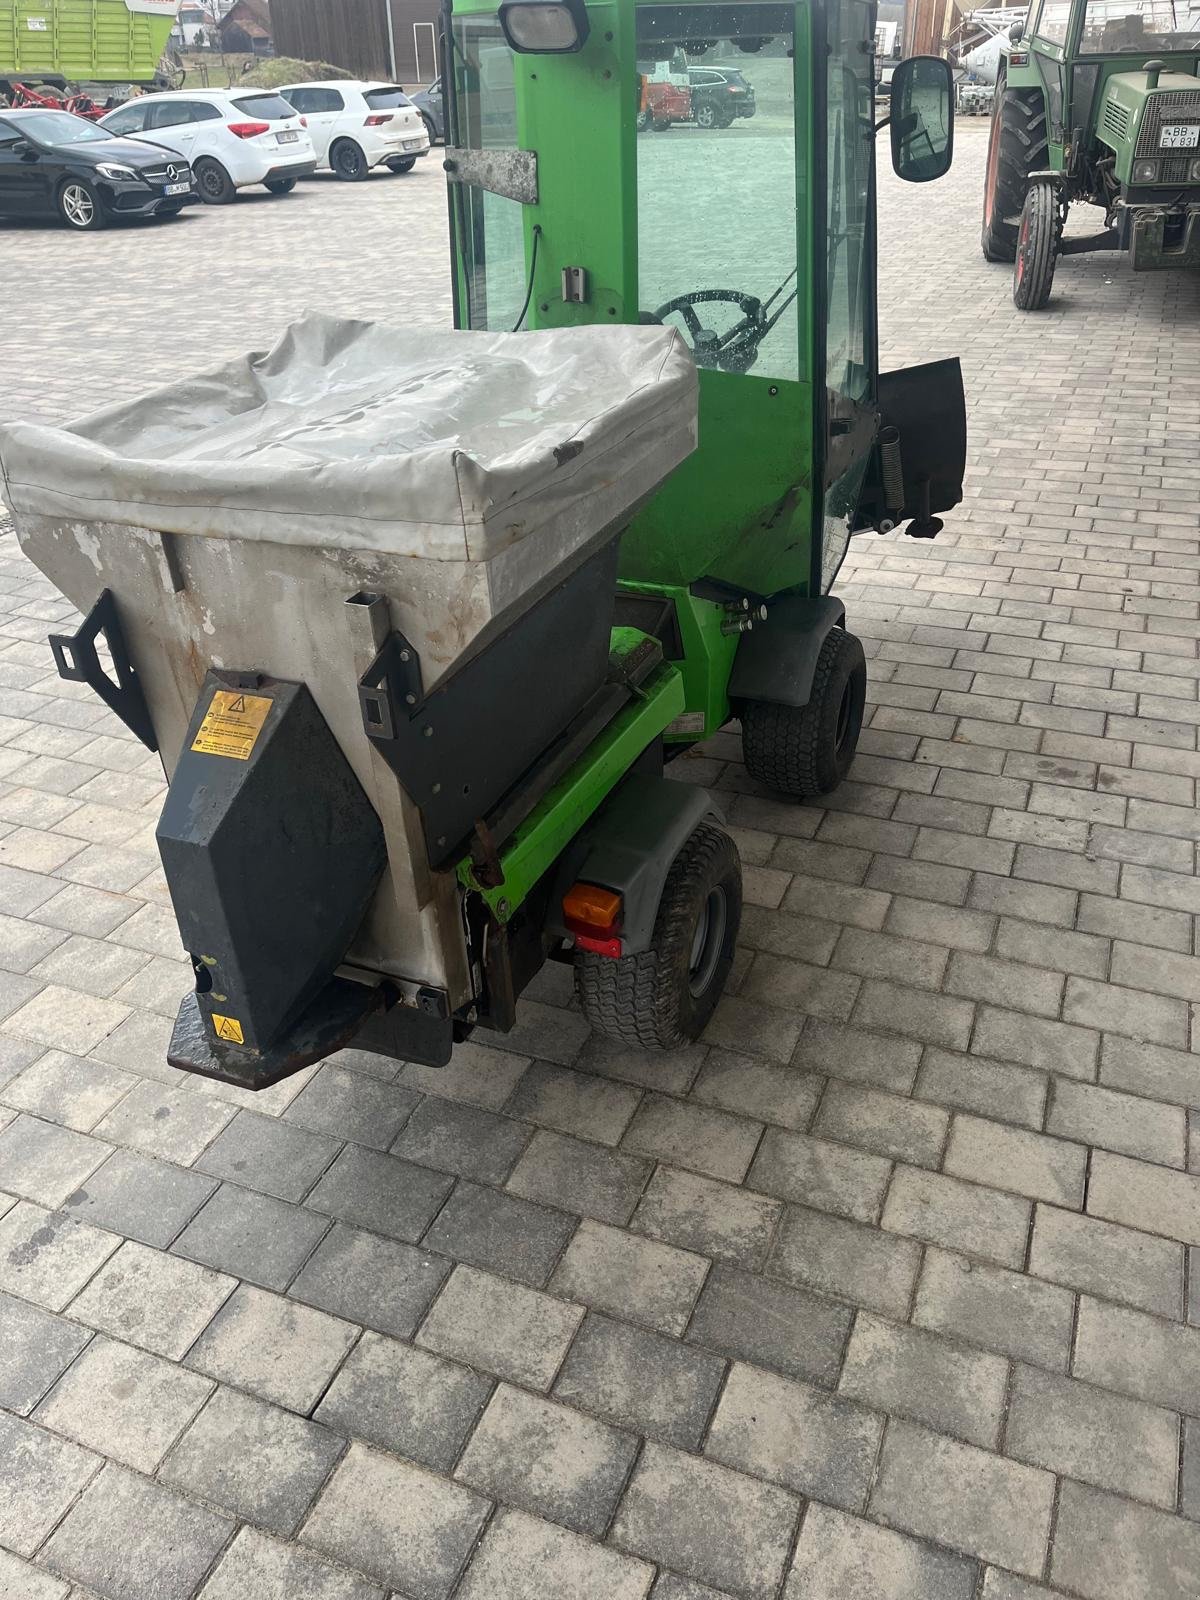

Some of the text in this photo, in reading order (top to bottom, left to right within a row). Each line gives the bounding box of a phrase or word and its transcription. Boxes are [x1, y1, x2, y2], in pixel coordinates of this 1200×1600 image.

[1173, 127, 1188, 136] BB
[1162, 137, 1196, 147] EY 831
